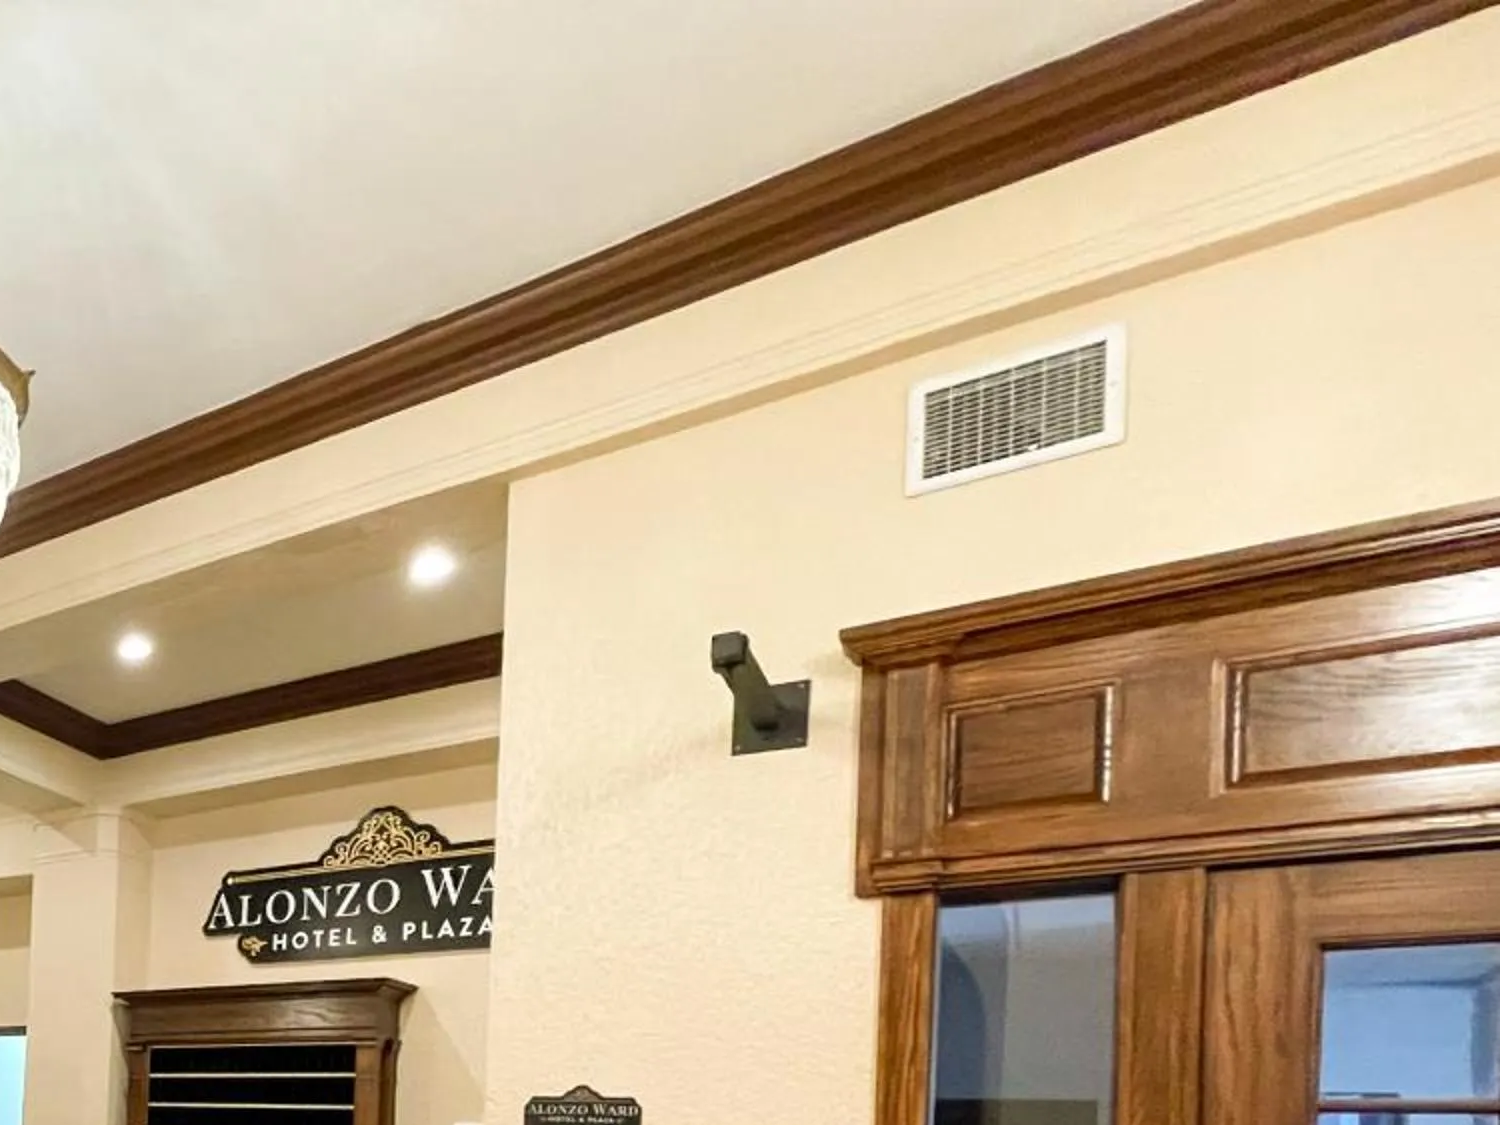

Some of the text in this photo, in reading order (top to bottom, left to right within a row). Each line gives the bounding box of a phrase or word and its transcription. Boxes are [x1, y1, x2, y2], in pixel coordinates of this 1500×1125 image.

[207, 864, 497, 930] ALONZO WA
[271, 914, 494, 952] HOTEL & PLAZA
[528, 1103, 639, 1117] ALONZO WARD
